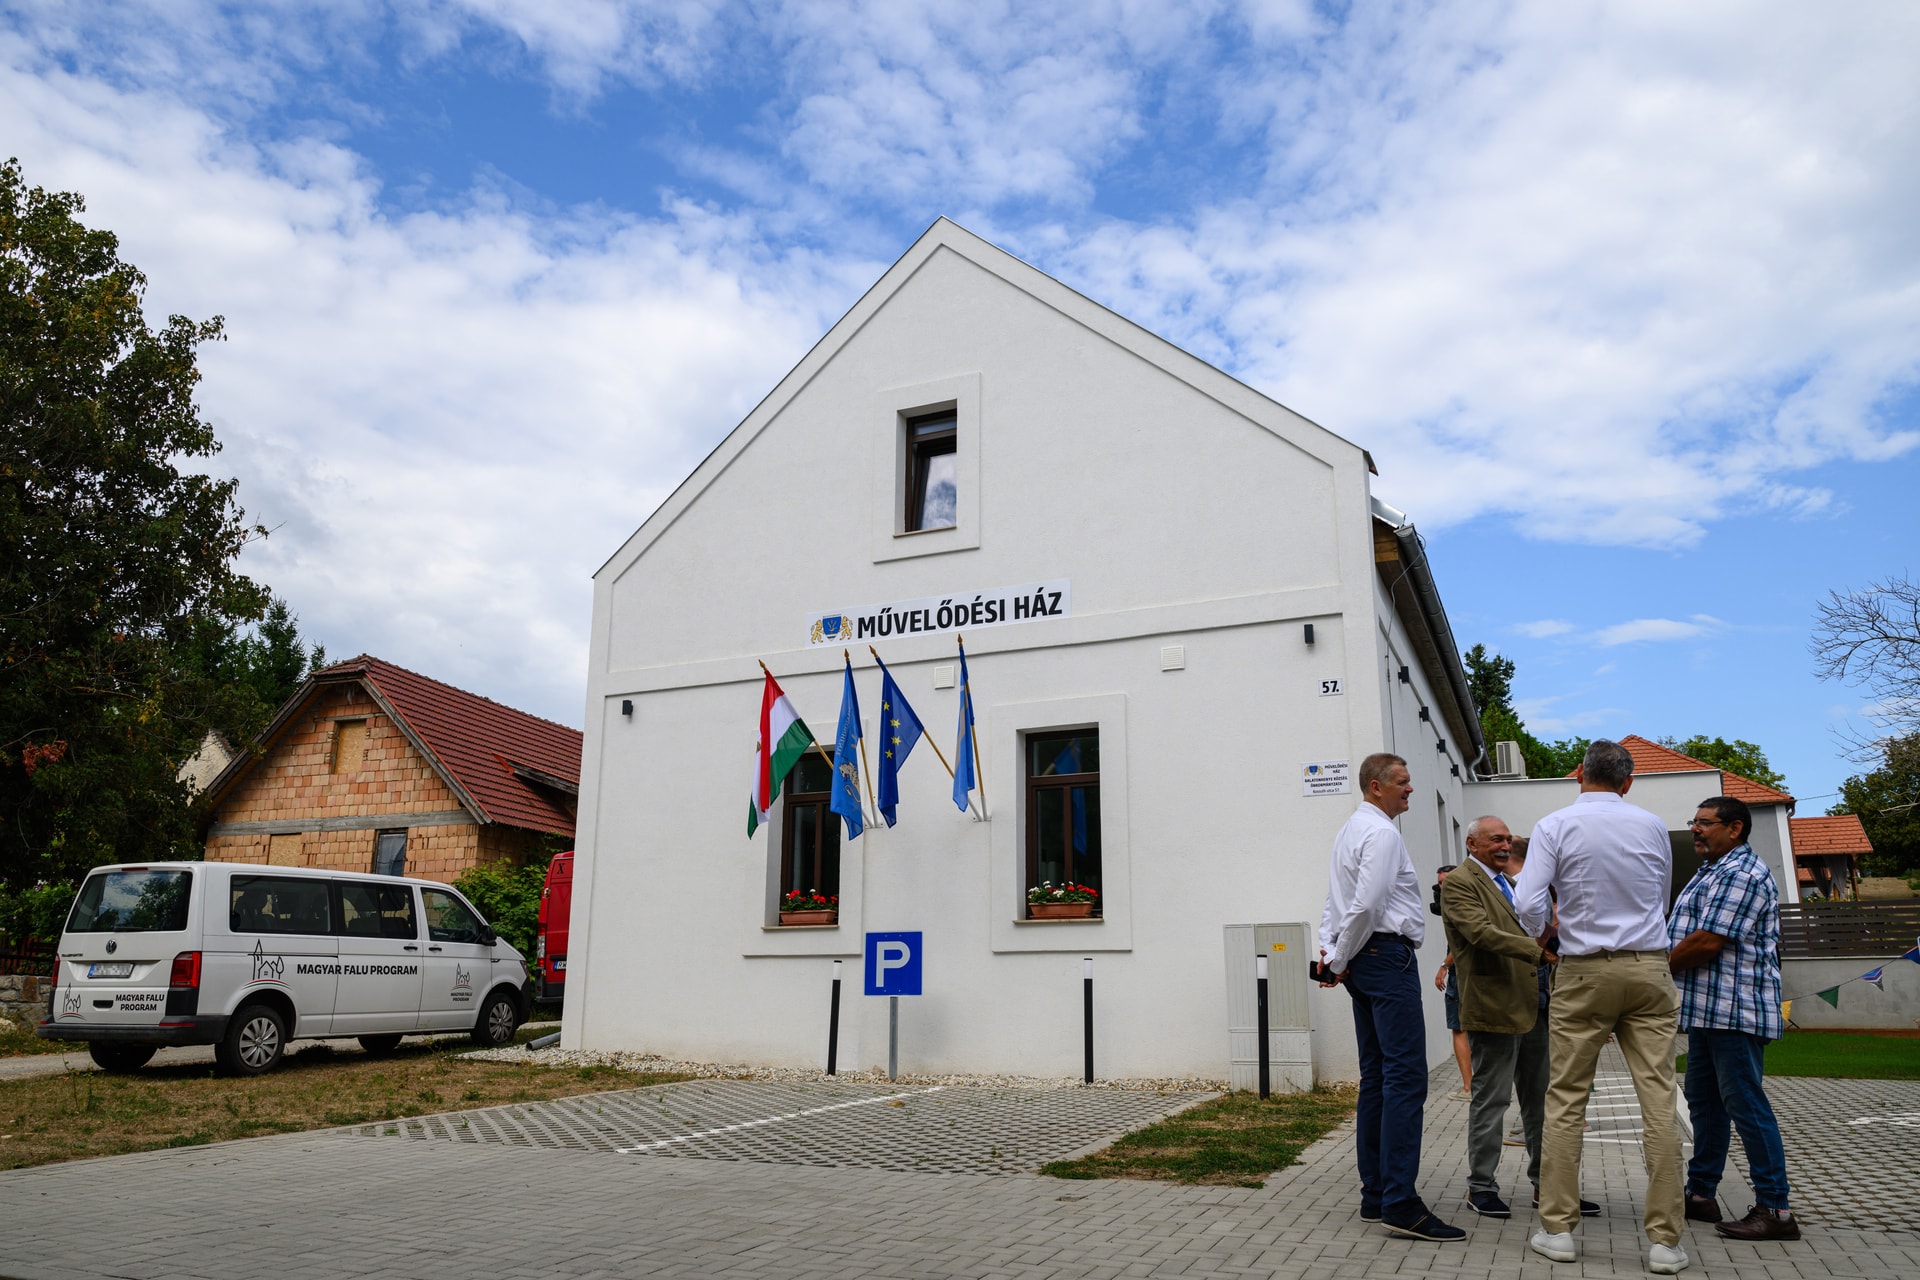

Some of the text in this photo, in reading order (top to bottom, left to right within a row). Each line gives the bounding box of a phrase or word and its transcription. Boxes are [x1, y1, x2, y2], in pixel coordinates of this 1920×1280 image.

[857, 586, 1063, 639] MŰVELŐDÉSI HÁZ
[1322, 680, 1339, 694] 57.
[296, 963, 418, 975] MAGYAR FALU PROGRAM
[875, 941, 911, 988] P
[115, 994, 145, 1002] MAGYAR
[120, 1003, 157, 1011] PROGRAM
